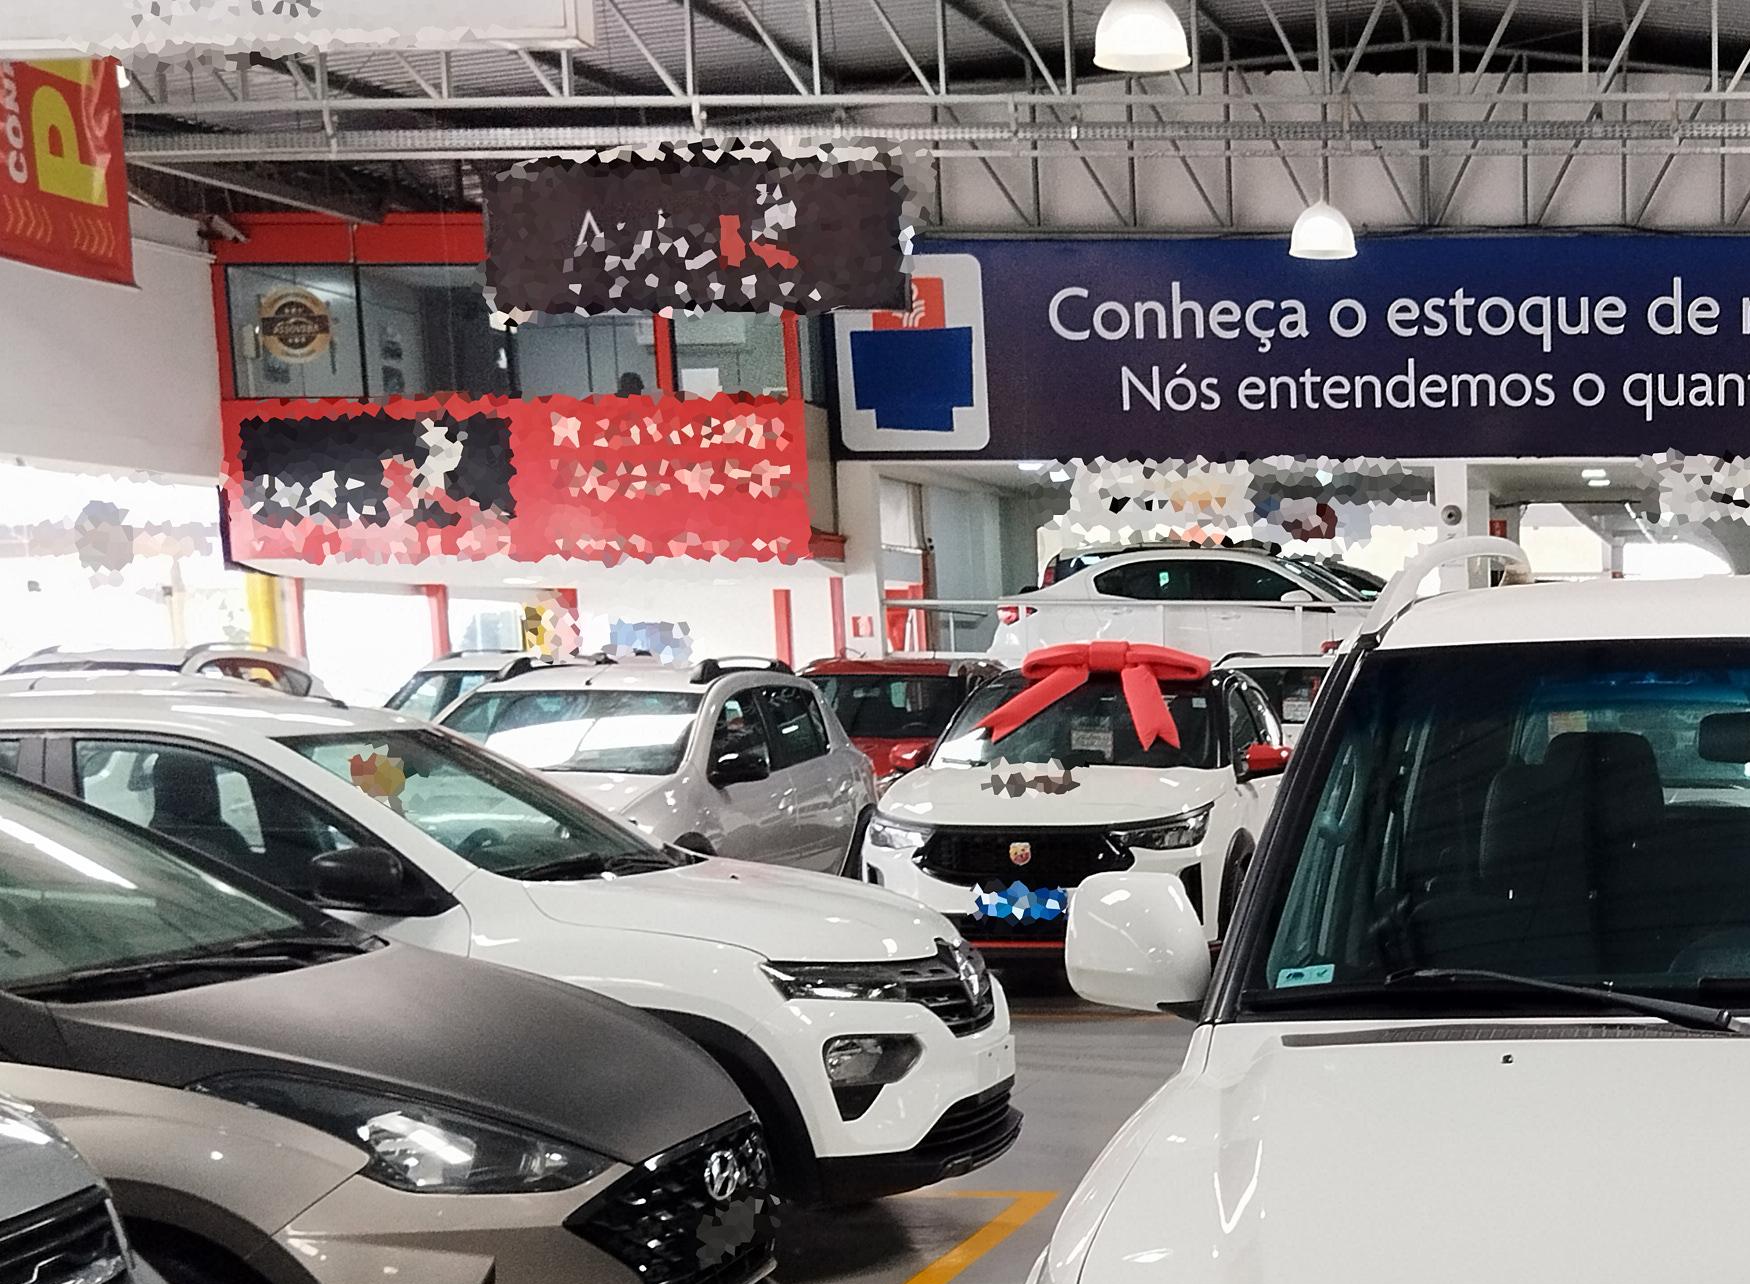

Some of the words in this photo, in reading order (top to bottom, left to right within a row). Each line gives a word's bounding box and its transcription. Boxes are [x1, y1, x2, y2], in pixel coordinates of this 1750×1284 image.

[1049, 282, 1310, 352] Conheça
[1330, 299, 1367, 338] o
[1387, 288, 1627, 353] estoque
[1648, 277, 1720, 336] de
[1122, 361, 1221, 412] Nós
[1238, 358, 1556, 410] entendemos
[1573, 373, 1606, 407] o
